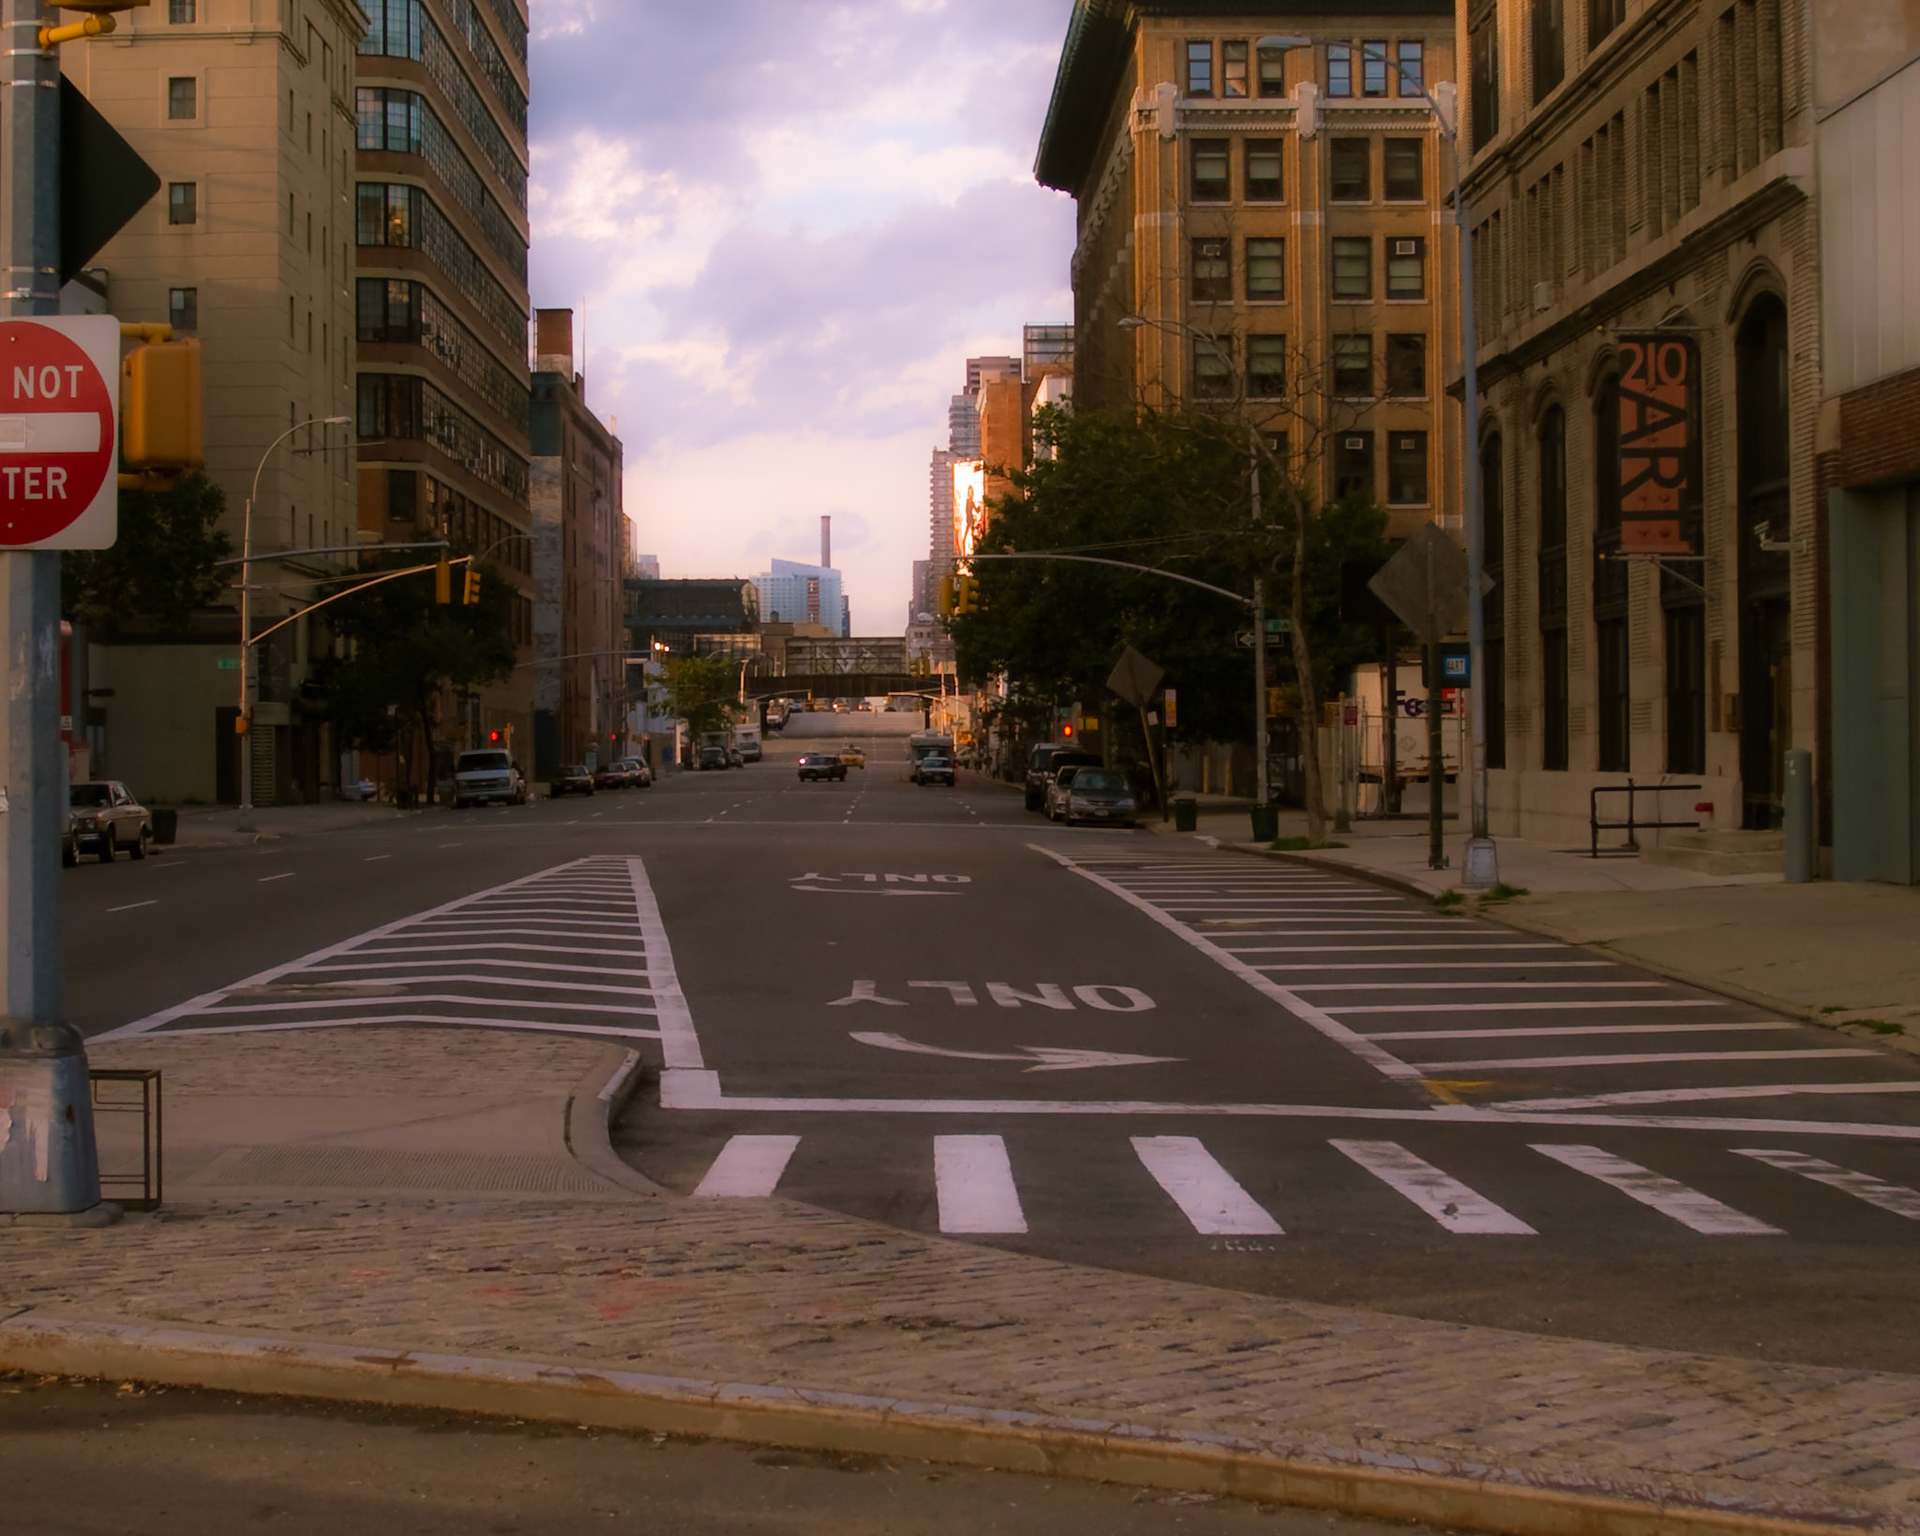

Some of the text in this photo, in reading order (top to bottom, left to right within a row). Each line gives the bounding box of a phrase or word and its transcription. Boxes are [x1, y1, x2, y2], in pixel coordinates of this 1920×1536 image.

[13, 365, 84, 400] NOT
[1618, 343, 1687, 387] 210
[1618, 386, 1688, 543] ART
[1, 466, 68, 501] TER
[786, 872, 972, 883] ONLY
[825, 979, 1157, 1012] ONLY
